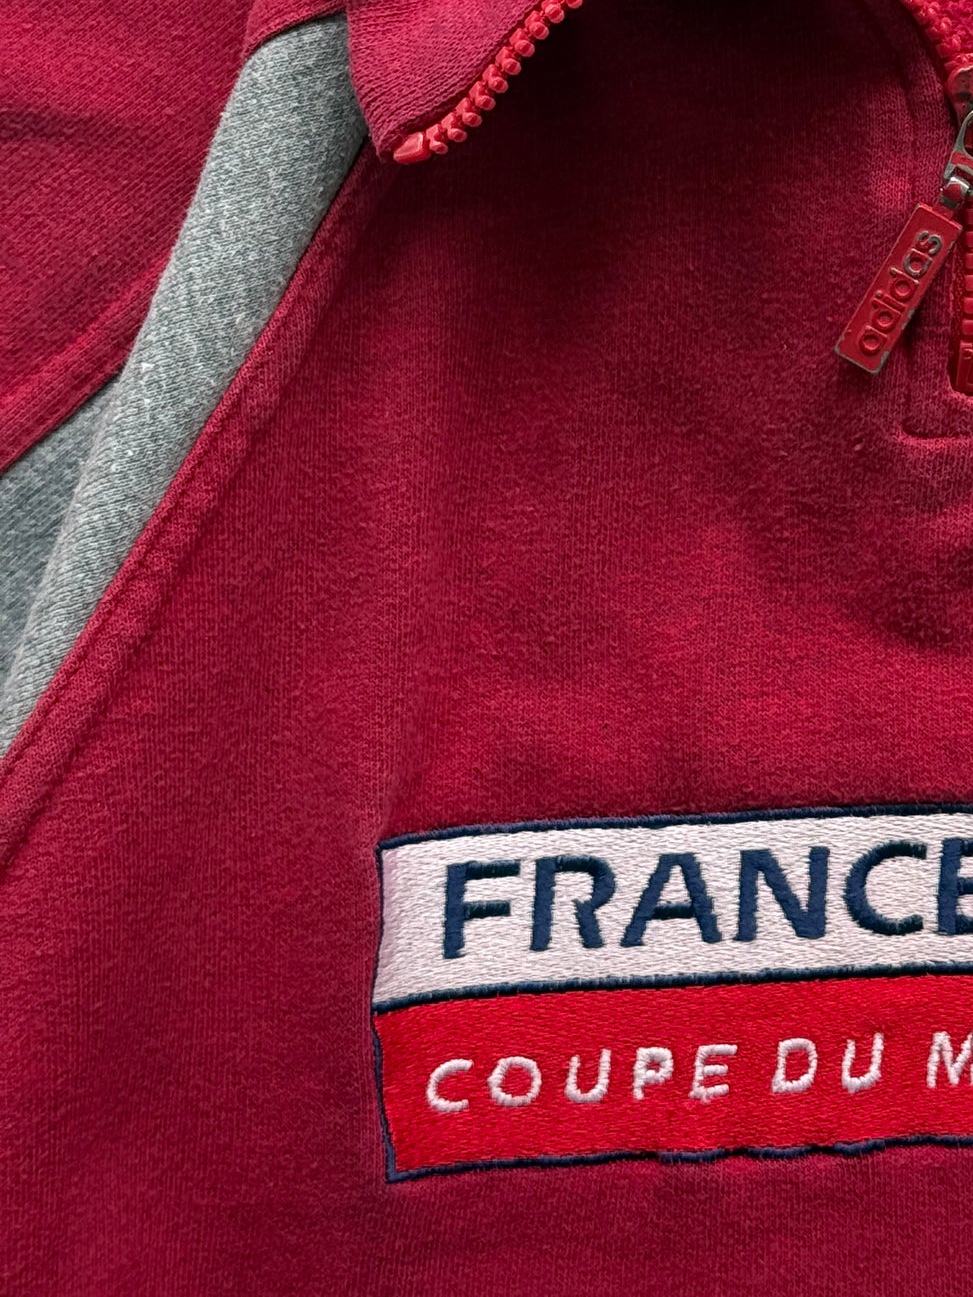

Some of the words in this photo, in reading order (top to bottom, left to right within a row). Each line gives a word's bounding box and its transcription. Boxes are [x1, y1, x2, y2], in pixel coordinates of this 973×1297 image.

[859, 229, 944, 357] adidas
[425, 1042, 739, 1113] COUPE
[771, 1031, 885, 1094] DU
